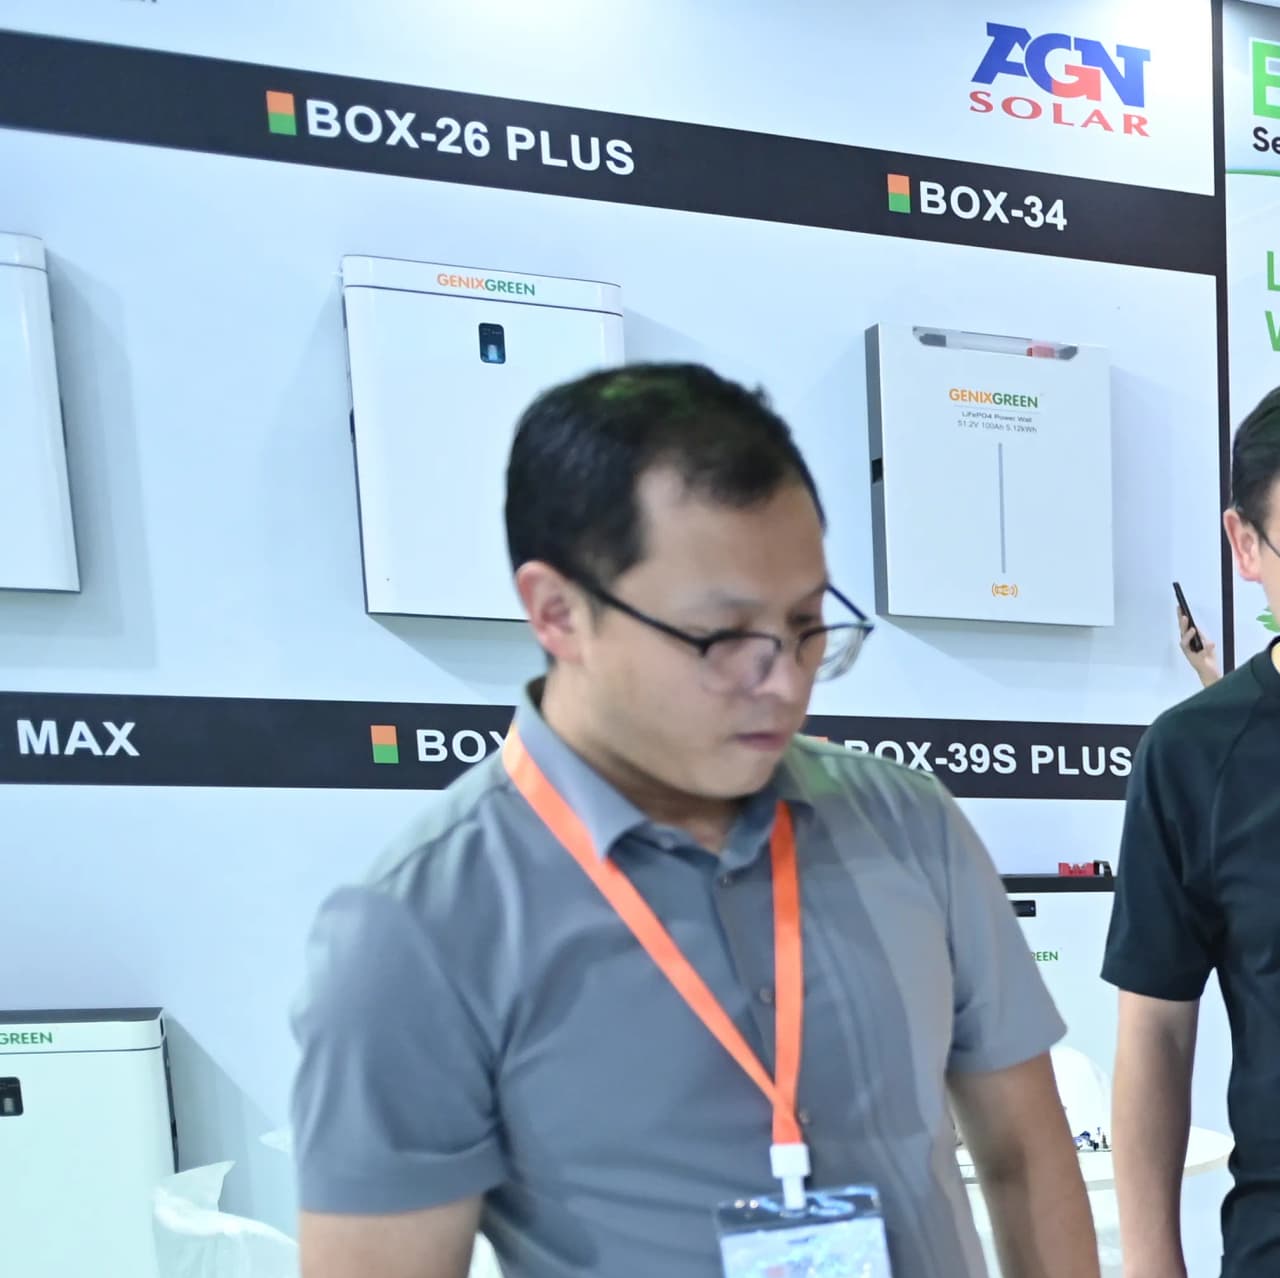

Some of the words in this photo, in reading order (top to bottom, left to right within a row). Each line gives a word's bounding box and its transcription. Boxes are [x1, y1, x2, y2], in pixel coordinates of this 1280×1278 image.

[970, 21, 1152, 108] AGN
[969, 90, 1151, 137] SOLAR
[306, 99, 490, 158] BOX-26
[507, 125, 636, 177] PLUS
[919, 181, 1068, 231] BOX-34
[436, 272, 536, 296] GENIXGREEN
[949, 387, 1039, 408] GENIXGREEN
[16, 719, 140, 756] MAX
[1030, 744, 1132, 777] PLUS
